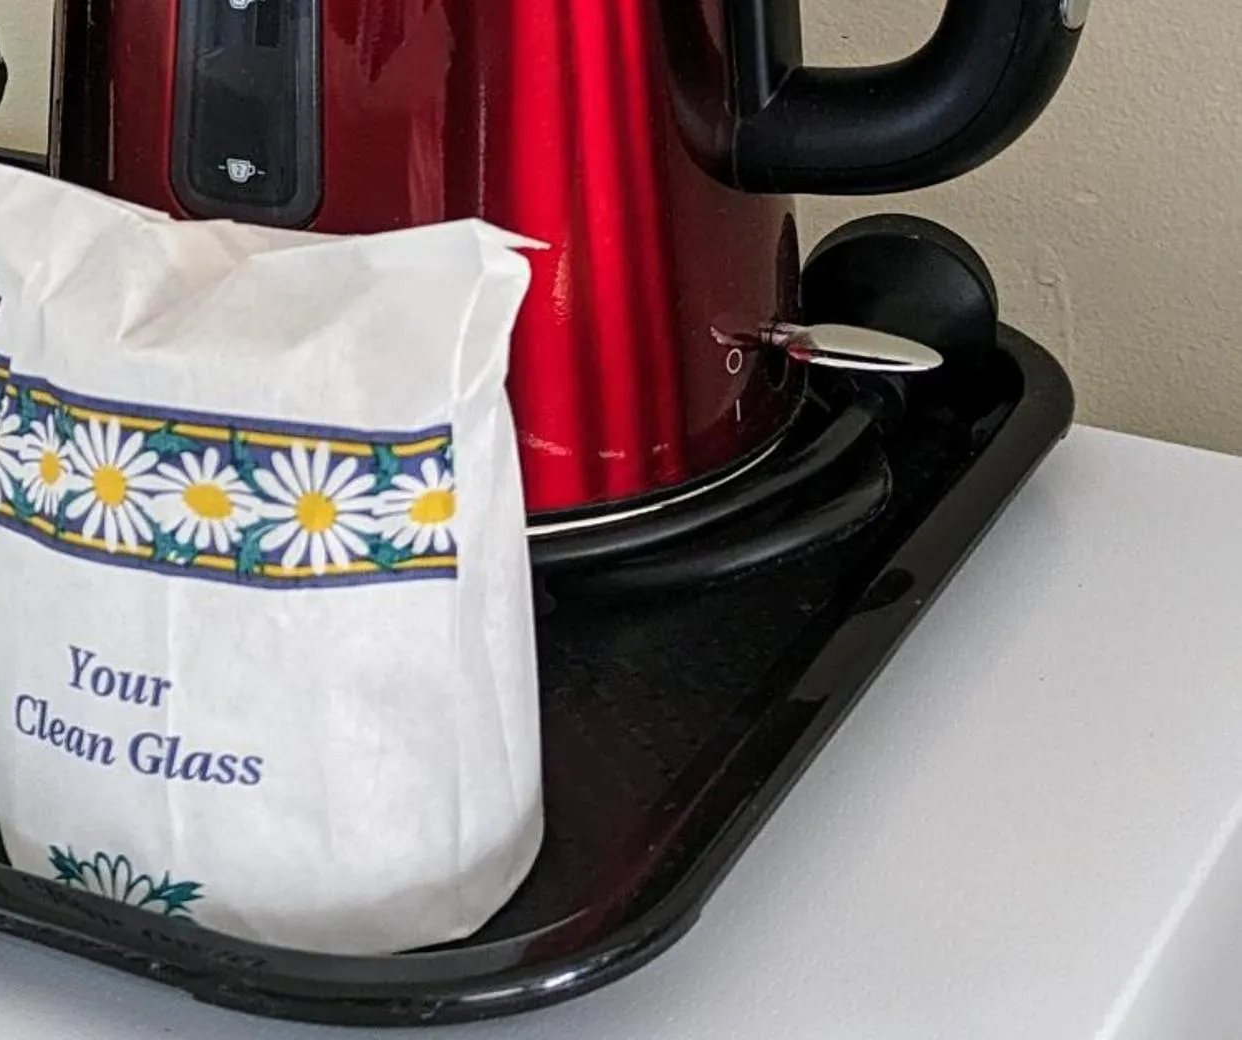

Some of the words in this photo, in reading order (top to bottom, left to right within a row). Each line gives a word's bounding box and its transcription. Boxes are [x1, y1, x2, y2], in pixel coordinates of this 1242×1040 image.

[68, 644, 172, 707] Your
[15, 694, 115, 766] Clean
[128, 731, 264, 786] Glass
